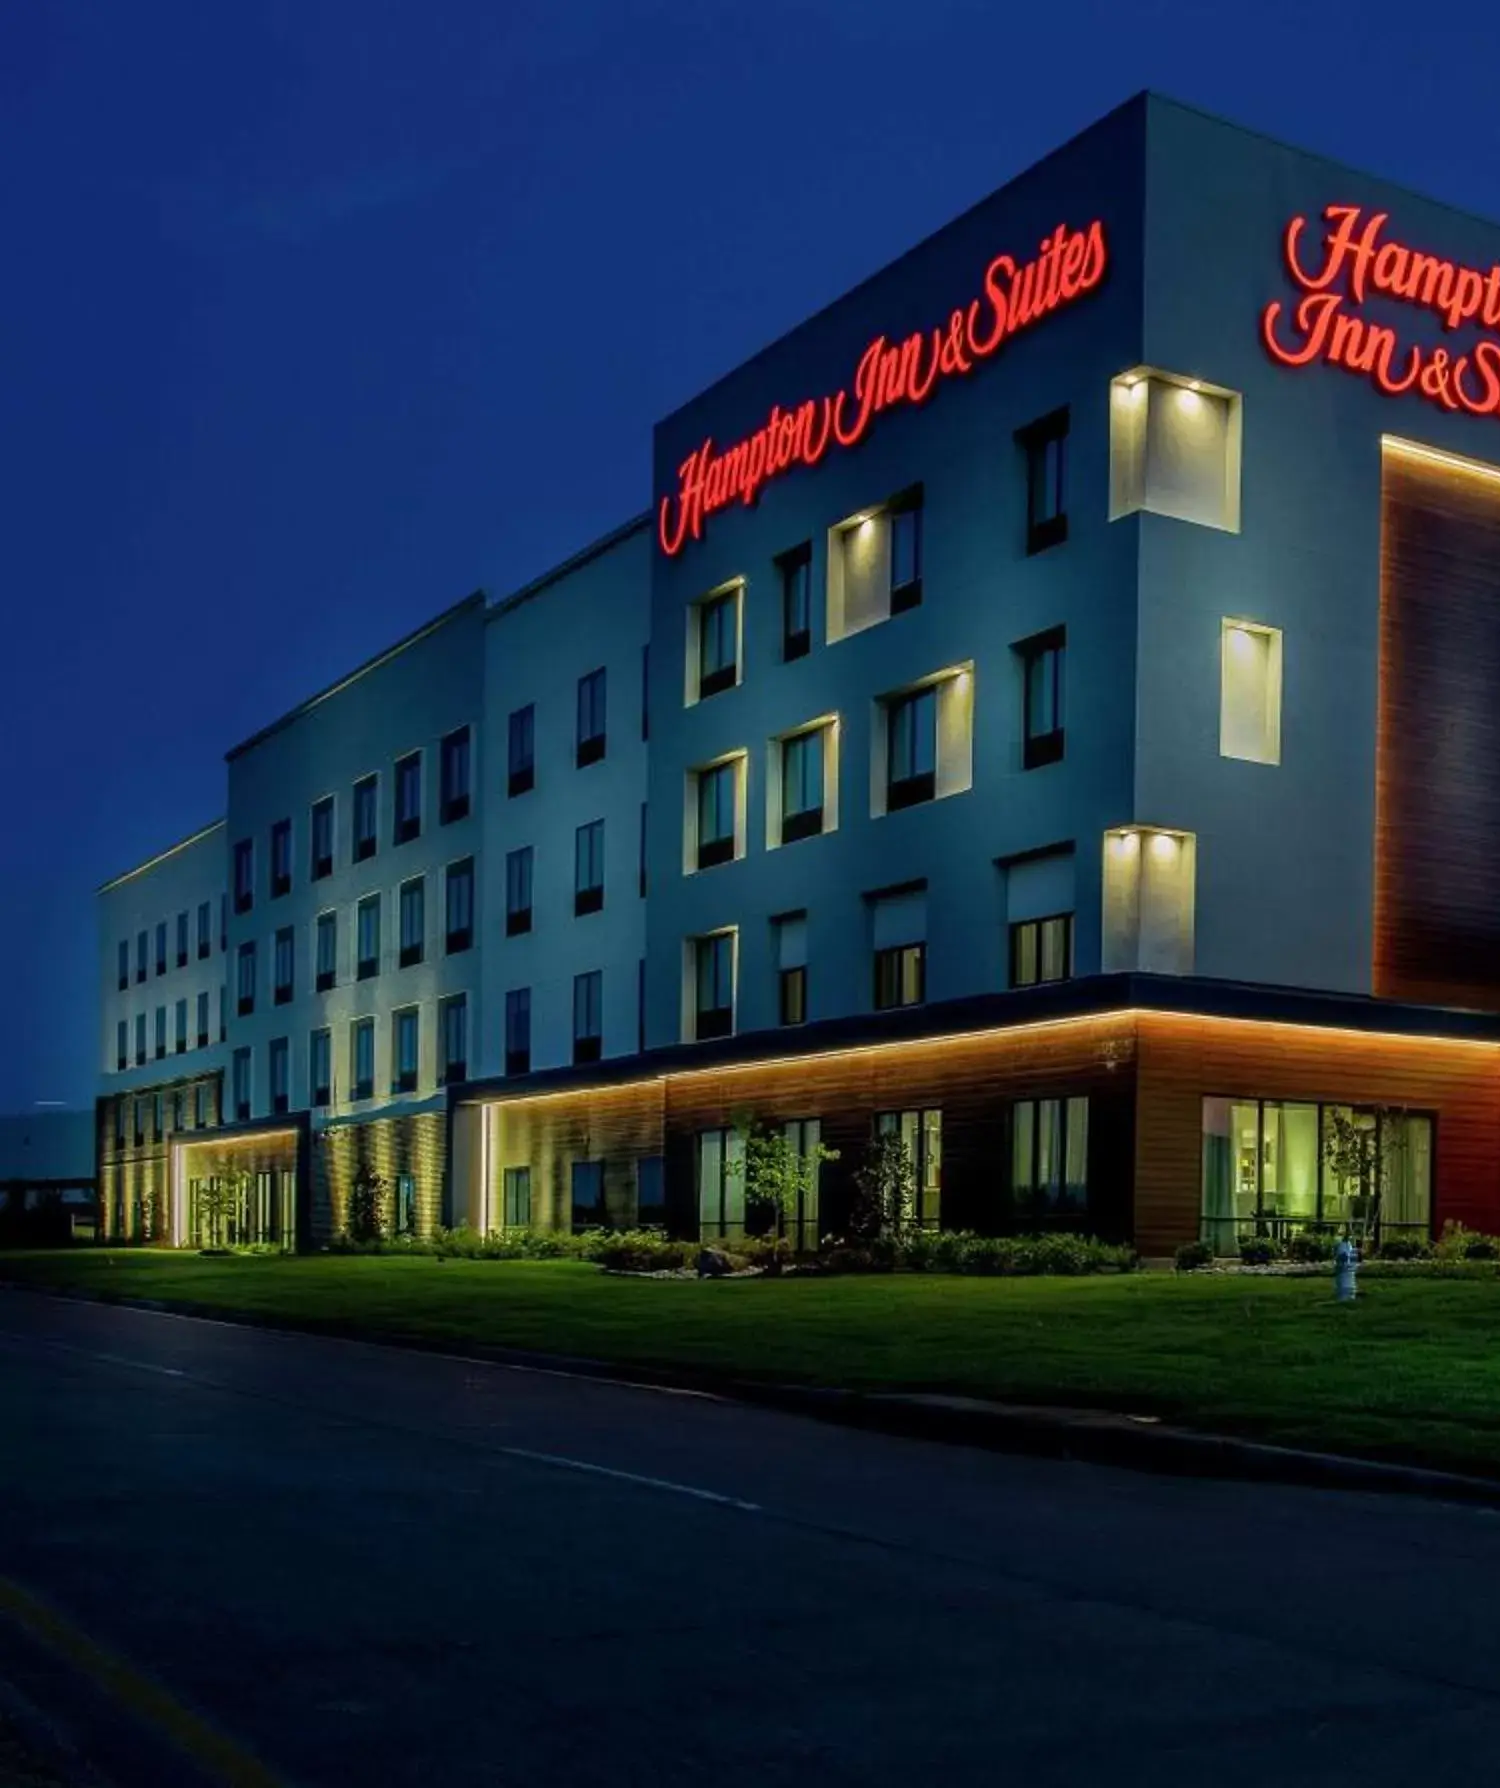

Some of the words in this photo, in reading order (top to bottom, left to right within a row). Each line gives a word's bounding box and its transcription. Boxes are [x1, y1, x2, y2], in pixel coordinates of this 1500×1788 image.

[660, 398, 831, 555] Hampton
[833, 335, 941, 446] Inn
[939, 309, 971, 373] &
[967, 220, 1106, 355] Suites
[1264, 292, 1421, 392] Inn
[1420, 347, 1458, 409] &
